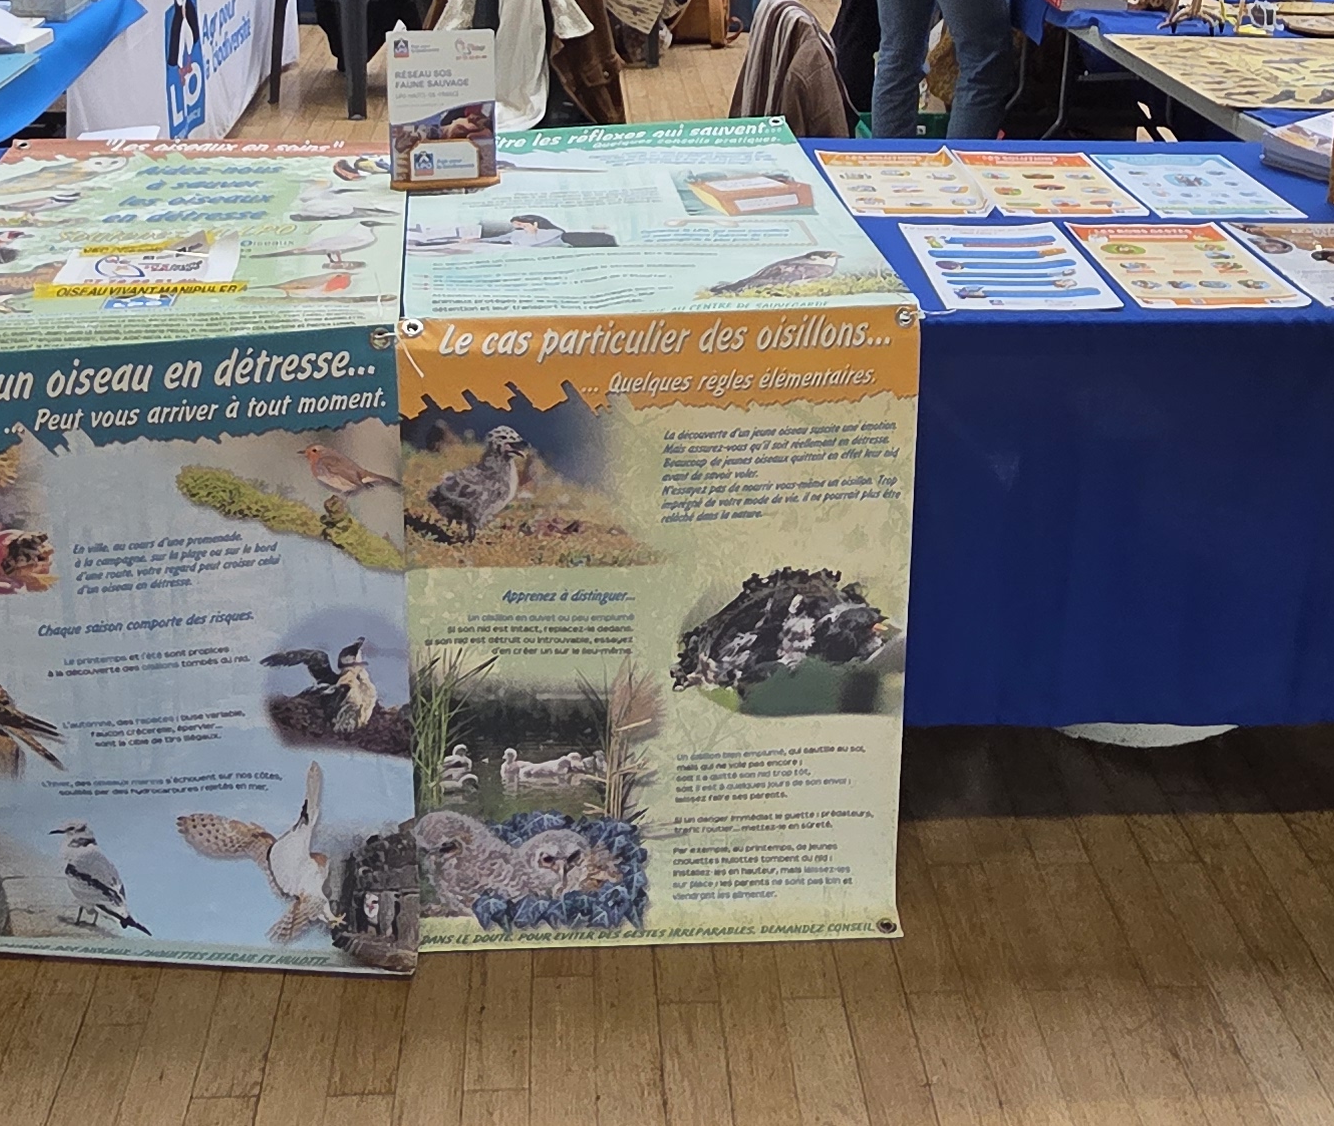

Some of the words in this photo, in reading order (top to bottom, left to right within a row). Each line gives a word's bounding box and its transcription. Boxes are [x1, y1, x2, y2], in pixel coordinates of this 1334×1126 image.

[395, 69, 431, 79] RÉSEAU
[433, 69, 452, 77] SOS
[395, 79, 424, 88] FAUNE
[427, 78, 469, 88] SAUVAGE
[533, 133, 559, 146] les
[567, 130, 646, 144] réflexes
[652, 125, 683, 140] qui
[153, 139, 238, 152] oiseaux
[242, 141, 268, 152] en
[171, 180, 264, 190] sauver
[119, 196, 164, 206] les
[168, 194, 274, 206] oiseaux
[102, 214, 139, 223] en
[145, 211, 267, 222] détresse
[56, 285, 108, 297] OISEAU
[159, 284, 237, 295] MANIPULER
[438, 324, 473, 356] Le
[481, 329, 533, 356] cas
[535, 319, 692, 364] particulier
[698, 317, 749, 354] des
[756, 314, 891, 351] oisillons...
[46, 358, 154, 398] oiseau
[163, 360, 203, 391] en
[214, 347, 376, 388] détresse...
[608, 371, 693, 399] Quelques
[696, 368, 754, 397] règles
[758, 363, 877, 390] élémentaires.
[34, 408, 84, 432] Peut
[90, 406, 140, 428] vous
[147, 399, 219, 424] arriver
[225, 395, 240, 419] à
[247, 395, 292, 417] tout
[297, 387, 387, 415] moment.
[664, 430, 676, 441] La
[678, 428, 727, 441] découverte
[730, 428, 750, 440] d'un
[750, 426, 776, 440] jeune
[778, 426, 808, 436] oiseau
[809, 424, 839, 435] suscite
[842, 423, 859, 432] une
[663, 443, 685, 454] Mais
[688, 442, 747, 454] assurez-vous
[750, 440, 770, 452] qu'il
[772, 440, 789, 450] soit
[839, 438, 849, 447] en
[73, 544, 85, 554] En
[113, 543, 125, 552] au
[128, 541, 155, 551] cours
[158, 537, 184, 549] d'une
[75, 558, 81, 568] à
[84, 557, 93, 567] la
[150, 553, 167, 562] sur
[169, 550, 179, 561] la
[180, 547, 207, 562] plage
[210, 549, 222, 557] ou
[225, 547, 240, 556] sur
[243, 544, 252, 554] le
[254, 541, 278, 553] bord
[76, 571, 103, 582] d'une
[137, 567, 161, 577] votre
[164, 562, 196, 576] regard
[198, 562, 221, 573] peut
[223, 557, 256, 570] croiser
[258, 554, 282, 565] celui
[77, 584, 99, 595] d'un
[102, 582, 133, 593] oiseau
[136, 582, 148, 590] en
[502, 589, 556, 603] Apprenez
[560, 590, 568, 602] à
[38, 624, 82, 638] Chaque
[85, 620, 123, 634] saison
[126, 616, 182, 631] comporte
[186, 613, 207, 624] des
[209, 609, 254, 626] risques.
[421, 934, 452, 945] DANS
[456, 934, 468, 944] LE
[518, 932, 552, 941] POUR
[598, 930, 620, 939] DES
[623, 928, 666, 938] GESTES
[760, 924, 824, 934] DEMANDEZ
[828, 922, 874, 932] CONSEIL
